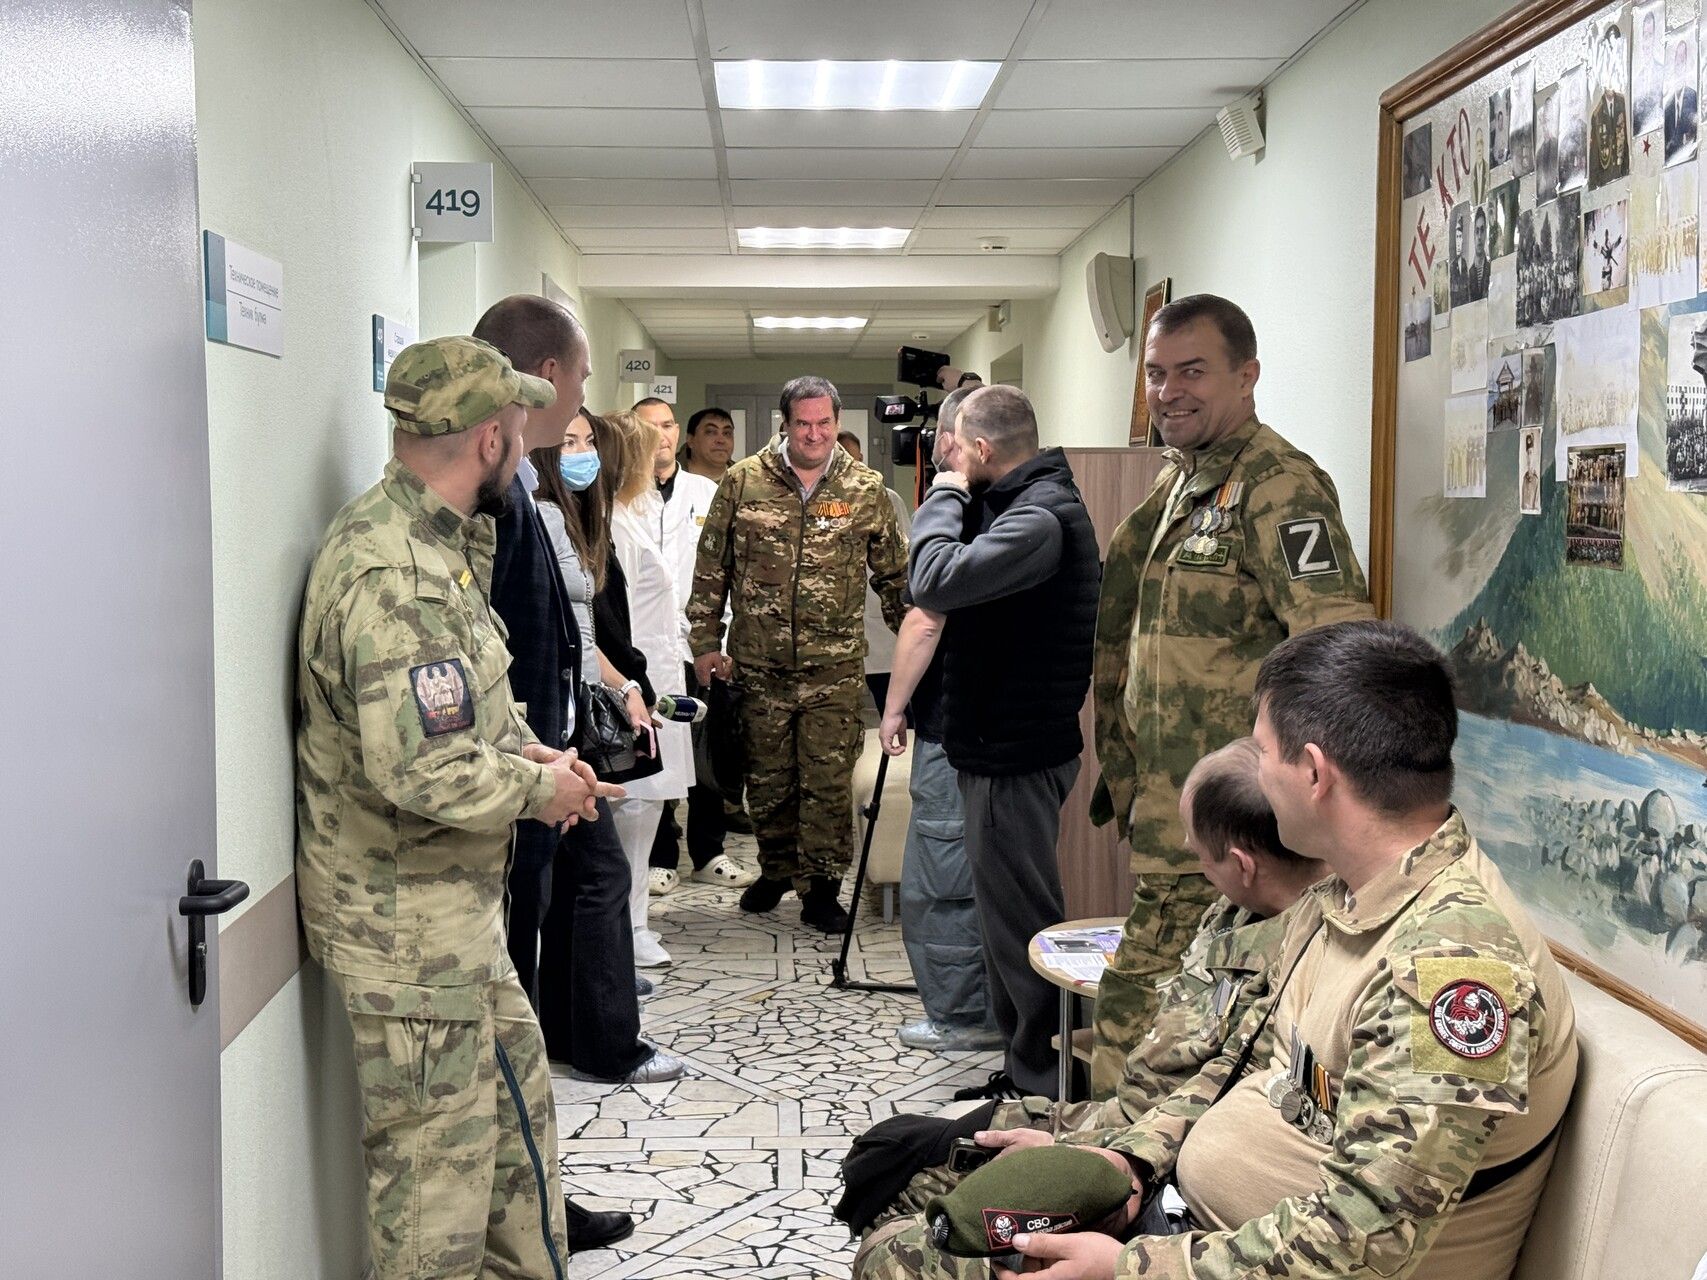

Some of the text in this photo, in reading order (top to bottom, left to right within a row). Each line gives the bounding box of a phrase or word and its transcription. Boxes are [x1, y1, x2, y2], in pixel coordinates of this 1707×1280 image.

[1436, 107, 1471, 222] КТО
[425, 189, 481, 217] 419
[625, 360, 651, 372] 420
[653, 384, 673, 395] 421
[1288, 522, 1331, 573] Z
[1026, 1216, 1051, 1231] СВО
